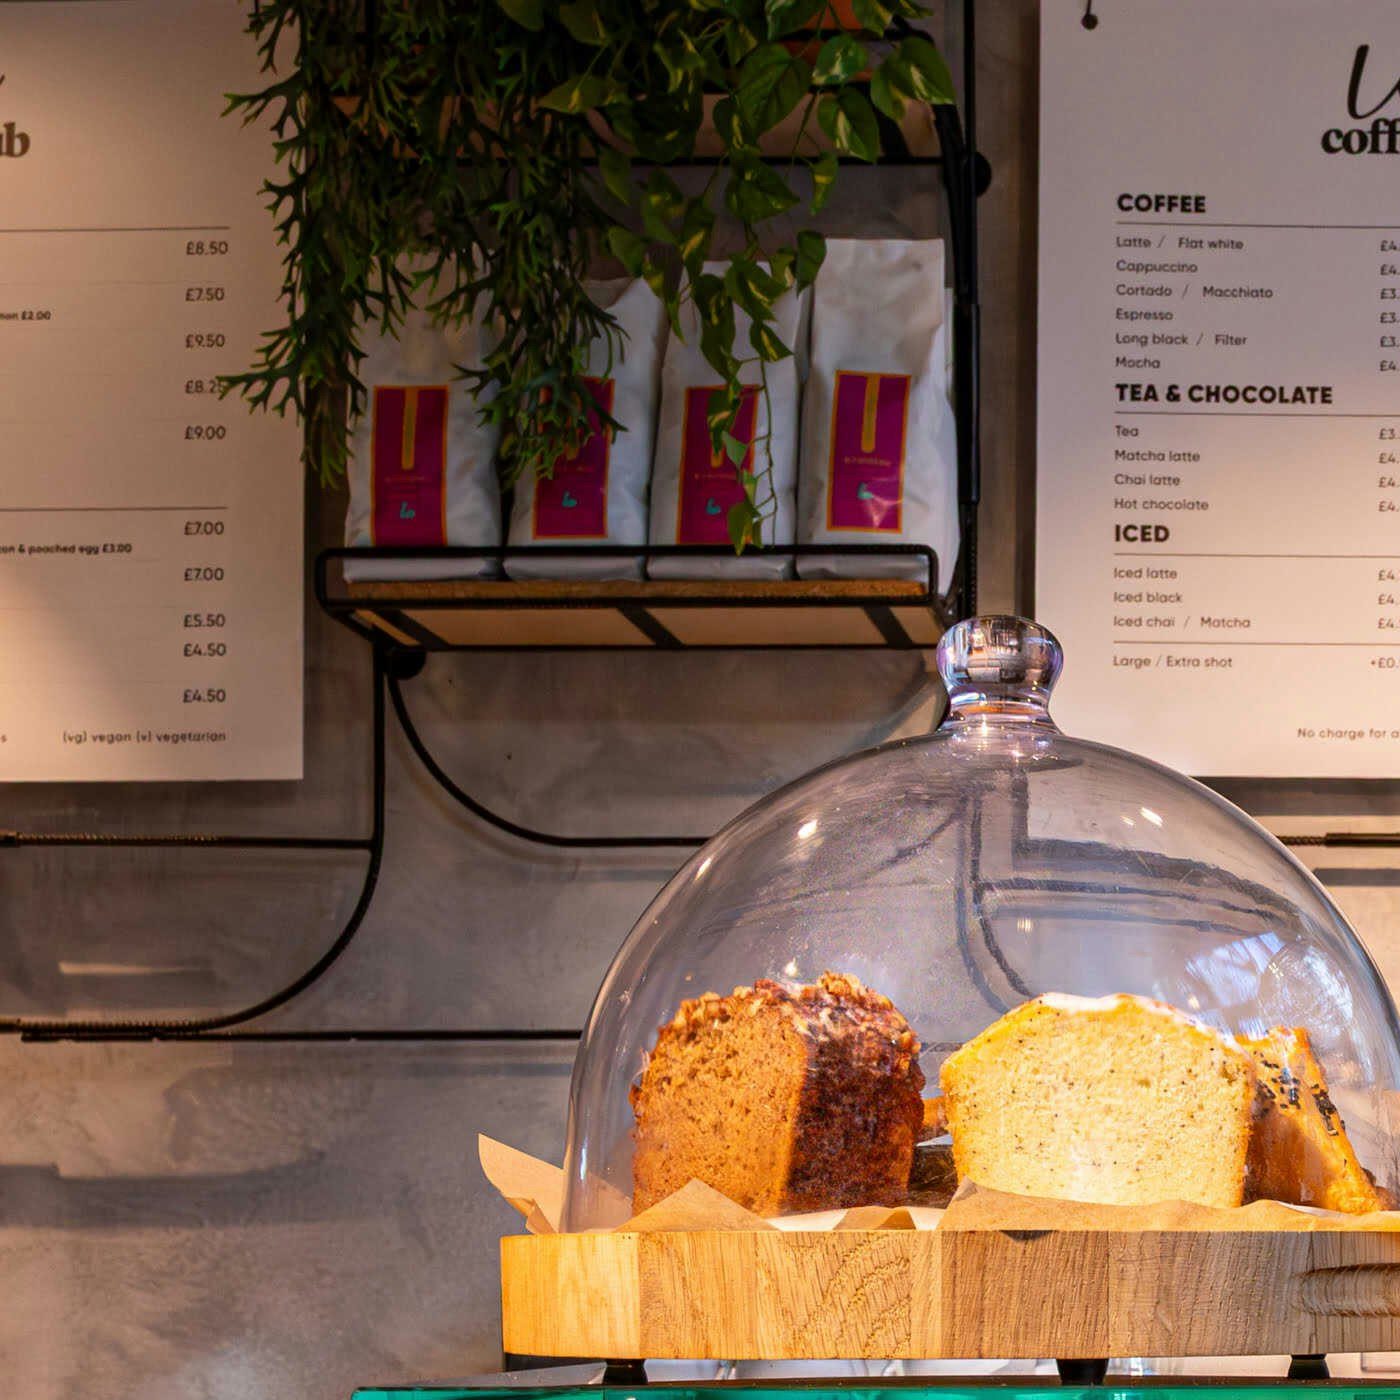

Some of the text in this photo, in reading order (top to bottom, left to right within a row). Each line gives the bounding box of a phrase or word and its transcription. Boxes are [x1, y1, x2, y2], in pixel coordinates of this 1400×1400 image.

[1117, 194, 1205, 213] COFFEE
[186, 241, 228, 255] £8.50
[1116, 237, 1151, 248] Latte
[1179, 237, 1203, 249] Flat
[1208, 240, 1243, 249] white
[1116, 260, 1198, 274] Cappuccino
[186, 288, 224, 301] £7.50
[1116, 284, 1172, 296] Cortado
[1203, 286, 1273, 298] Macchiato
[1116, 308, 1173, 321] Espresso
[186, 334, 225, 348] £9.50
[1116, 333, 1148, 347] Long
[1152, 334, 1188, 345] black
[1215, 334, 1246, 345] Filter
[1116, 356, 1160, 368] Mocha
[1116, 384, 1332, 404] TEA & CHOCOLATE
[185, 426, 226, 440] £9.00
[1115, 425, 1139, 437] Tea
[1115, 450, 1165, 461] Matcha
[1169, 451, 1200, 462] latte
[1114, 474, 1146, 485] Chai
[1150, 475, 1180, 486] latte
[1115, 498, 1137, 509] Hot
[1142, 499, 1209, 510] chocolate
[184, 521, 224, 535] £7.00
[1116, 525, 1169, 542] ICED
[184, 568, 224, 581] £7.00
[1114, 568, 1142, 578] Iced
[1147, 568, 1177, 579] latte
[1114, 592, 1142, 603] Iced
[1147, 592, 1181, 603] black
[184, 614, 225, 627] £5.50
[1114, 616, 1142, 627] Iced
[1146, 617, 1175, 627] chai
[1201, 617, 1250, 628] Matcha
[184, 643, 226, 657] £4.50
[1113, 656, 1151, 669] Large
[1167, 656, 1200, 667] Extra
[1204, 657, 1232, 667] shot
[183, 689, 226, 703] £4.50
